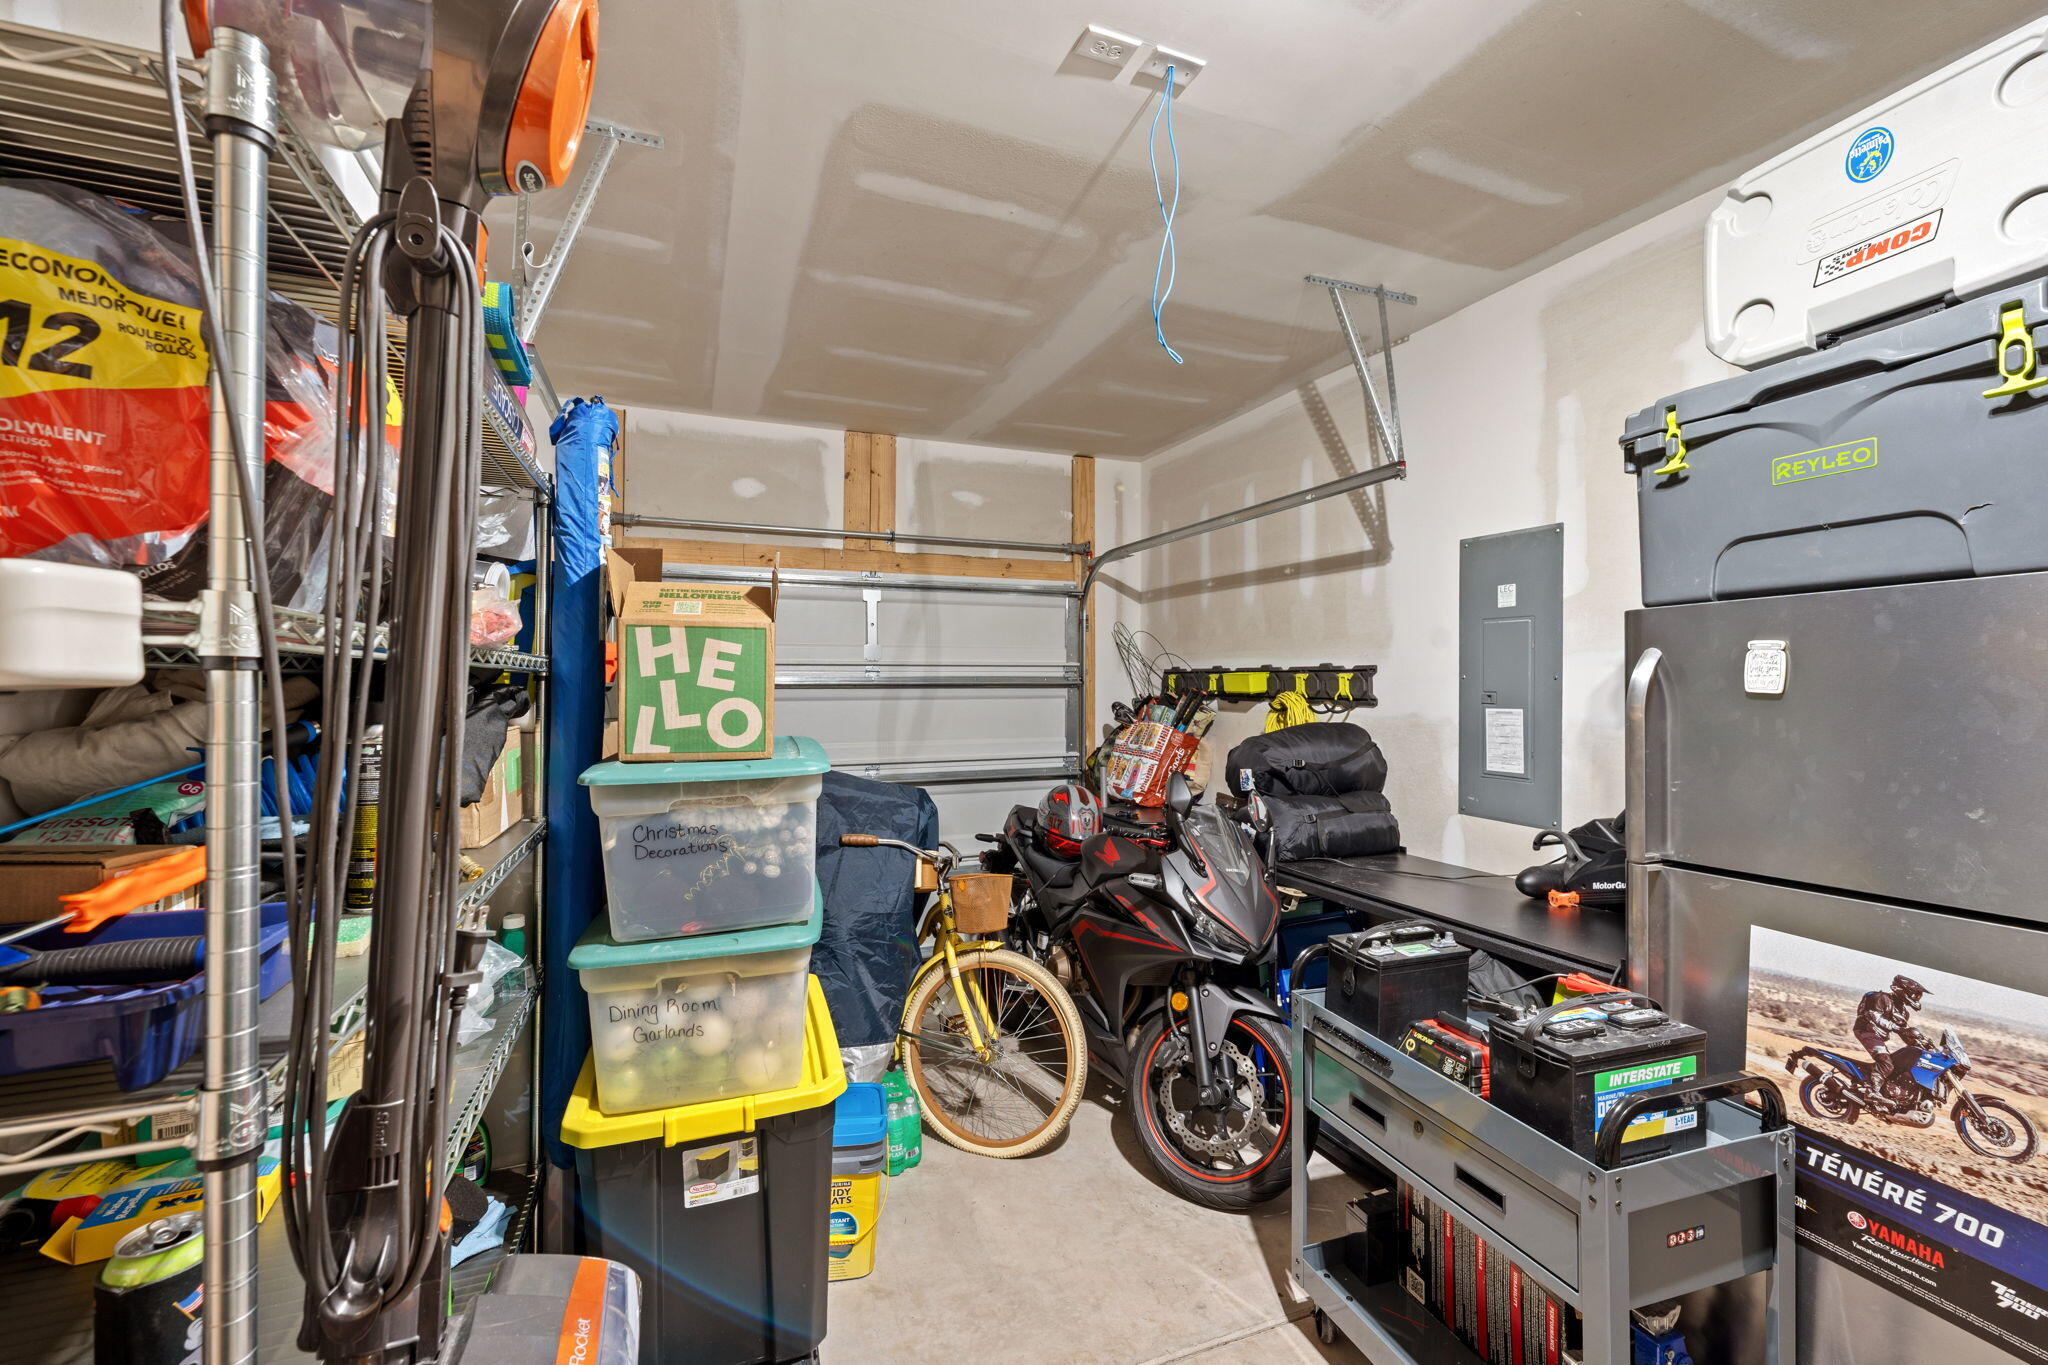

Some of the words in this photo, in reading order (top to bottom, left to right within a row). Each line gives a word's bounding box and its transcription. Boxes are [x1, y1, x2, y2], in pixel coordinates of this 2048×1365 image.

[1833, 243, 1872, 263] CAMS
[1846, 221, 1932, 268] COMP
[0, 299, 102, 380] 12
[0, 417, 107, 446] OLYVALENT
[1776, 447, 1872, 480] REYLEO
[138, 561, 178, 580] OLLOS
[659, 592, 744, 601] HELLOFRESH
[632, 823, 719, 844] Christmas
[633, 841, 729, 861] Decorations
[1592, 881, 1627, 890] MotorGu
[608, 1002, 659, 1025] Dining
[666, 998, 719, 1014] Room
[632, 1023, 705, 1044] Garlands
[1609, 1061, 1682, 1087] INTERSTATE
[1674, 1114, 1695, 1126] 1-YEAR
[831, 1197, 852, 1205] ATS
[832, 1188, 852, 1197] IDY
[1806, 1146, 1928, 1215] TÉNÉRÉ
[1933, 1201, 2005, 1249] 700
[1861, 1233, 1890, 1251] Revs
[1889, 1247, 1912, 1262] Your
[1910, 1257, 1938, 1272] Heart
[1868, 1218, 1945, 1269] YAMAHA
[1852, 1240, 1937, 1288] YamahaMotorsports.com
[1996, 1295, 2041, 1321] 700
